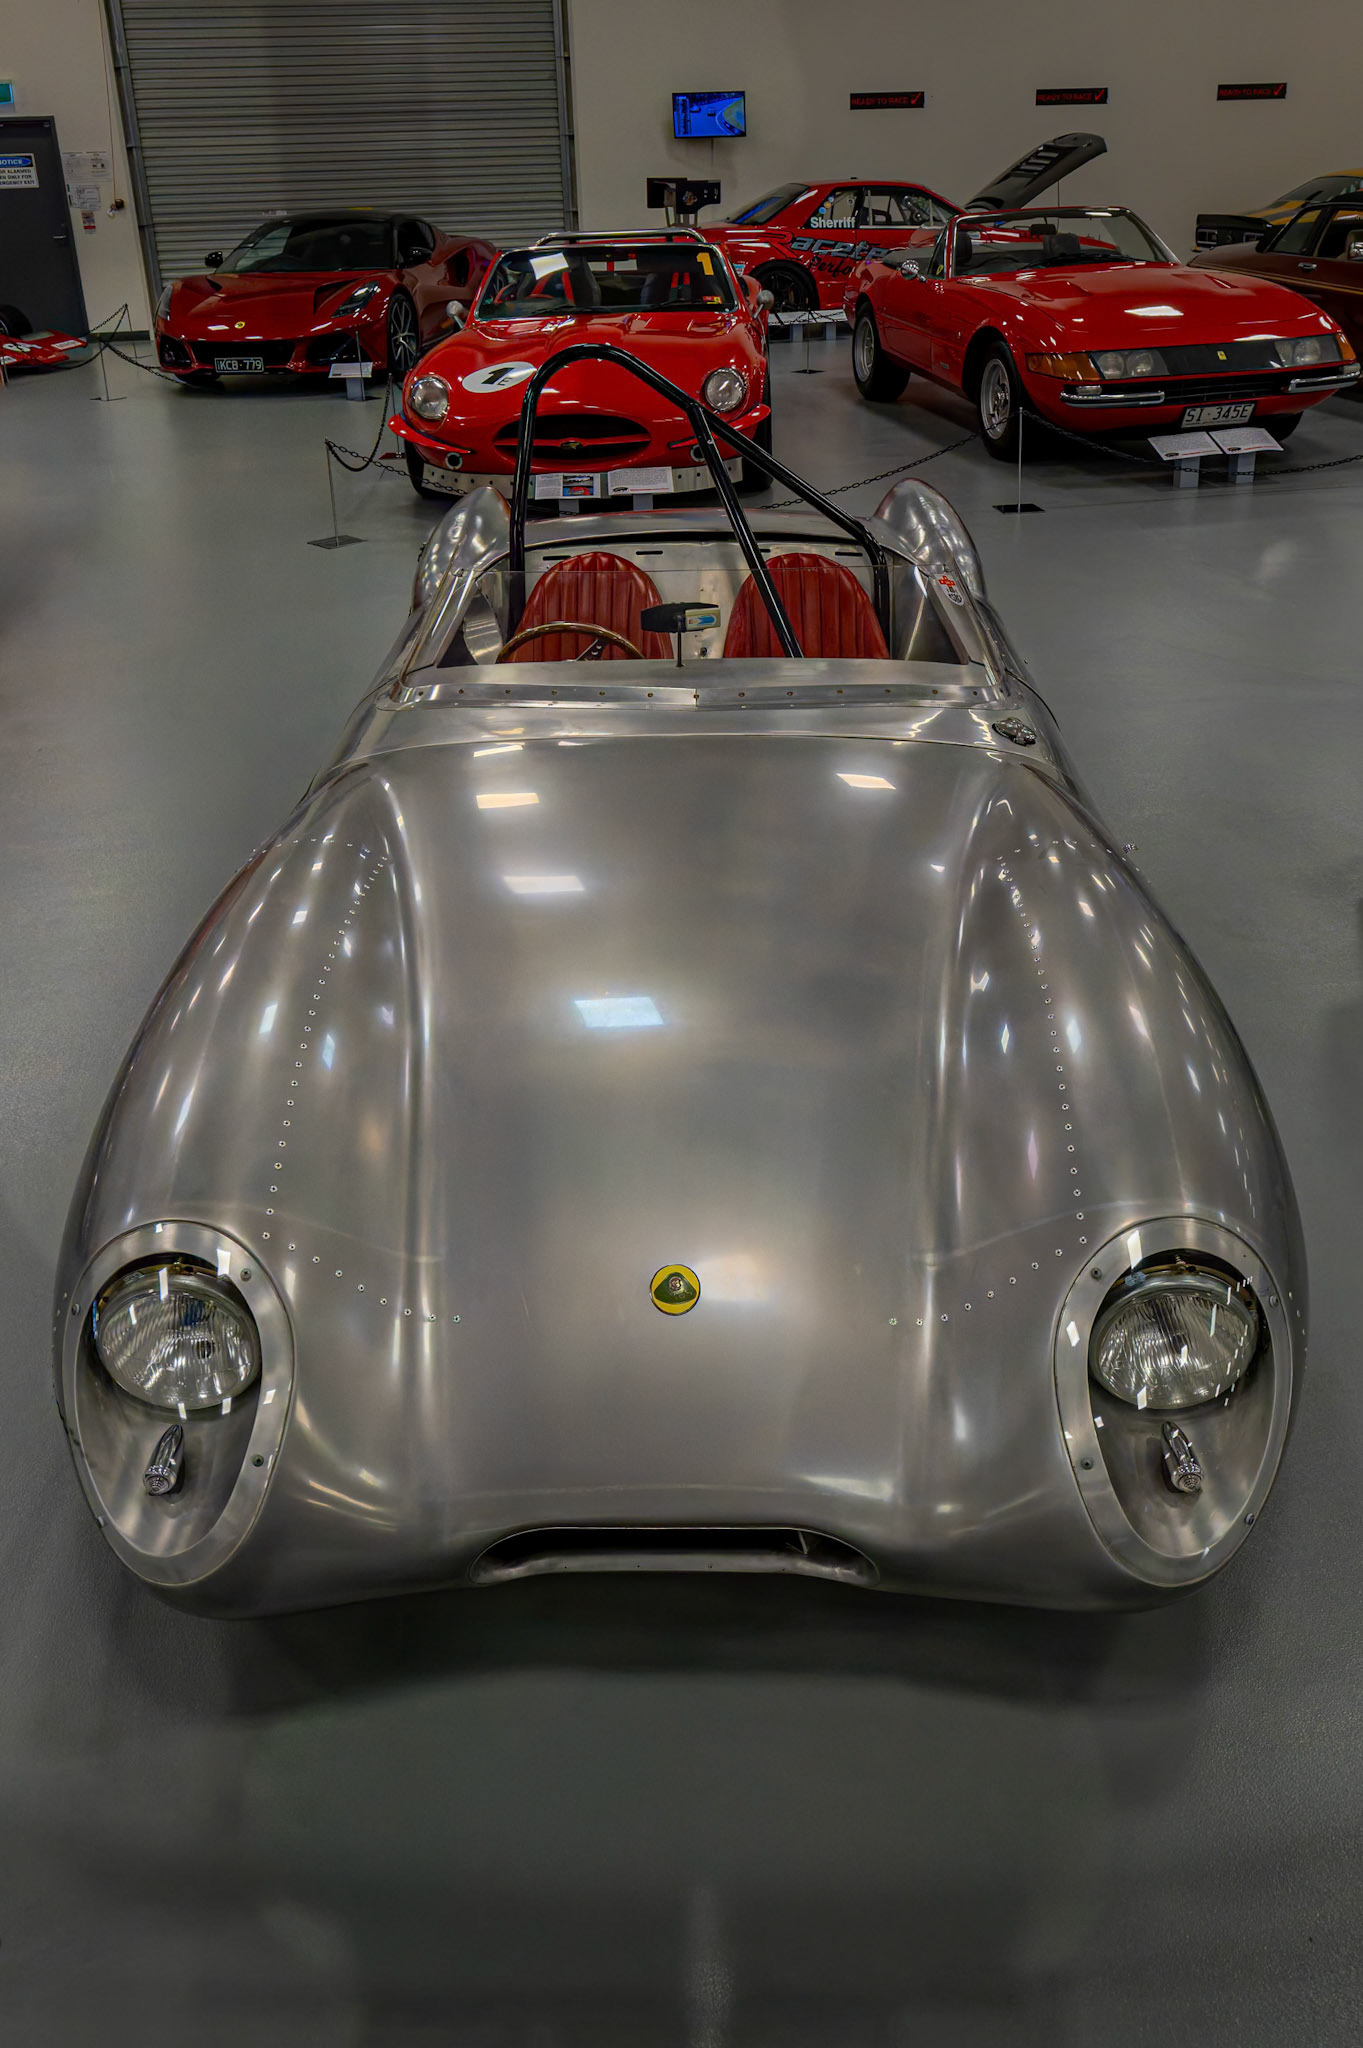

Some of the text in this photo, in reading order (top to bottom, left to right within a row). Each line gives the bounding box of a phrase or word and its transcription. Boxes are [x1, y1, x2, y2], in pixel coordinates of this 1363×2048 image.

[0, 158, 23, 166] OTICE
[810, 216, 856, 229] Sherriff
[696, 252, 715, 276] 1
[481, 367, 515, 385] 1
